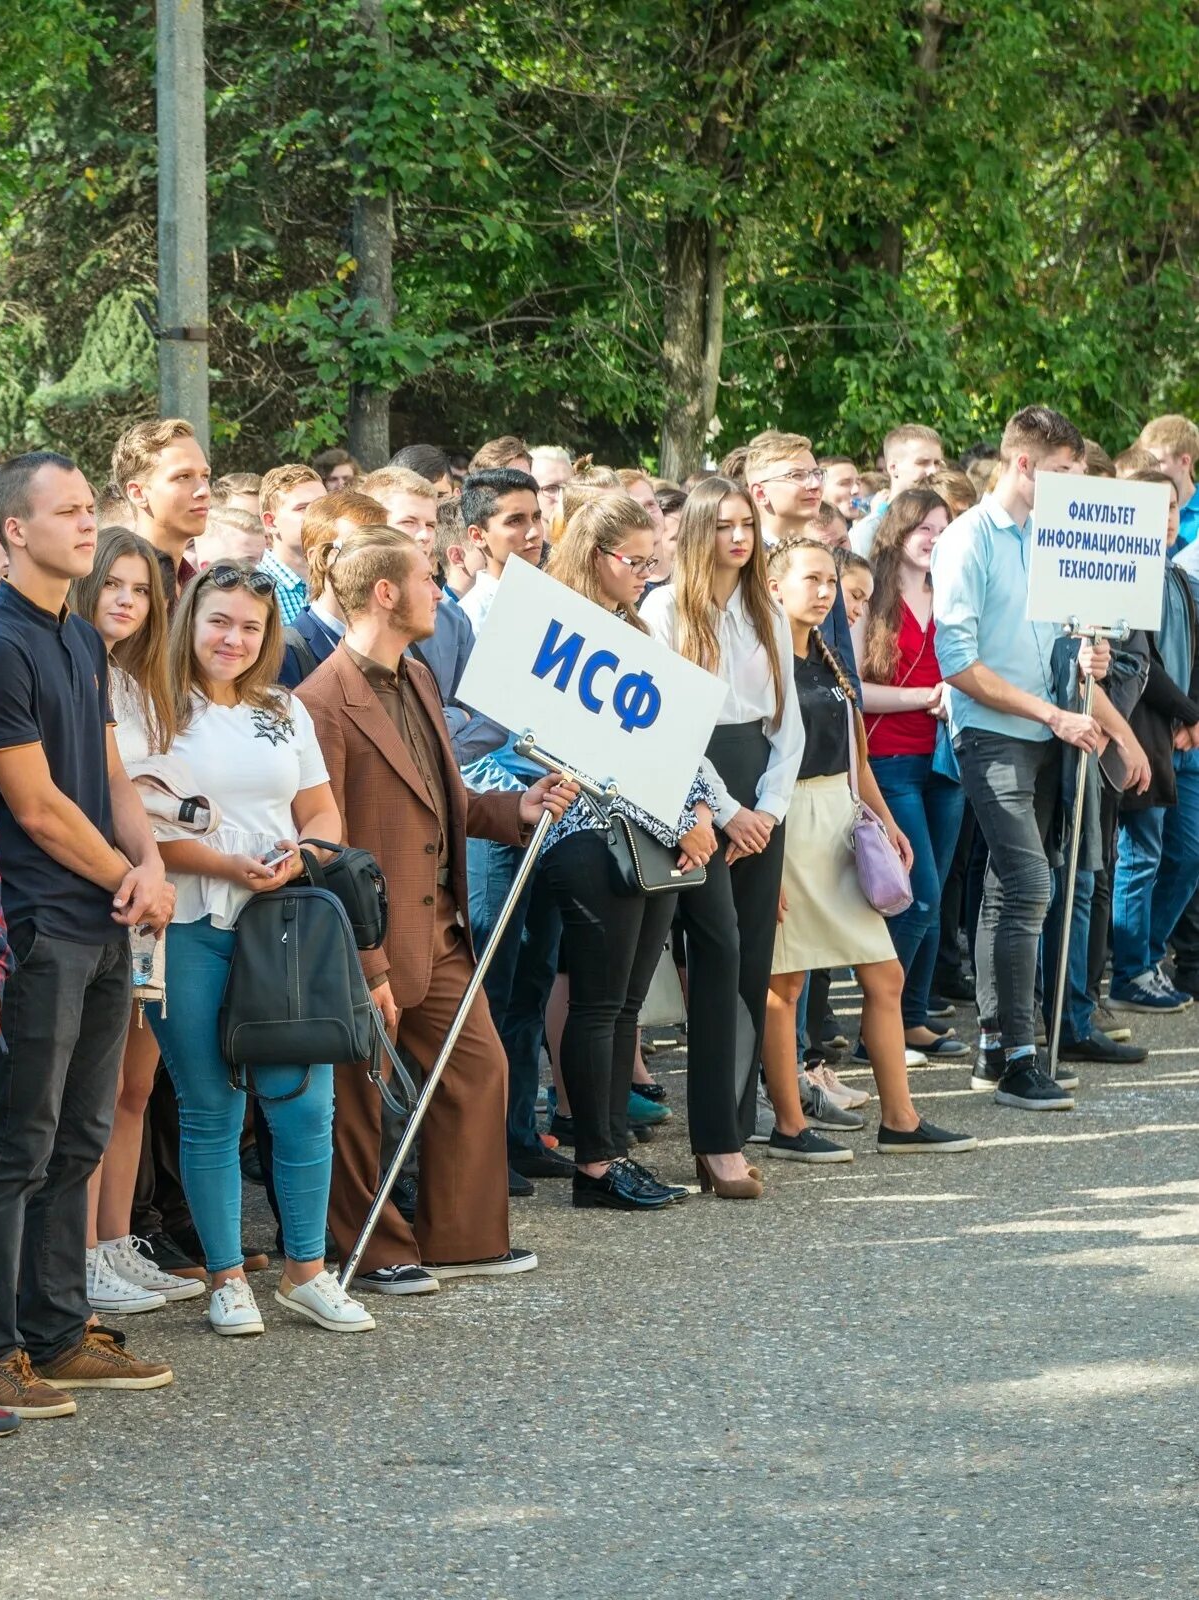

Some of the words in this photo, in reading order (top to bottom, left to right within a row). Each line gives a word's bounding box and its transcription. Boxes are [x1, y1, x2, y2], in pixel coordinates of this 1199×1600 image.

[1069, 501, 1135, 525] ФАКУЛЬТЕТ
[1037, 528, 1161, 557] ИНФОРМАЦИОННЫХ
[1059, 559, 1137, 583] ТЕХНОЛОГИЙ
[531, 618, 662, 734] ИСФ
